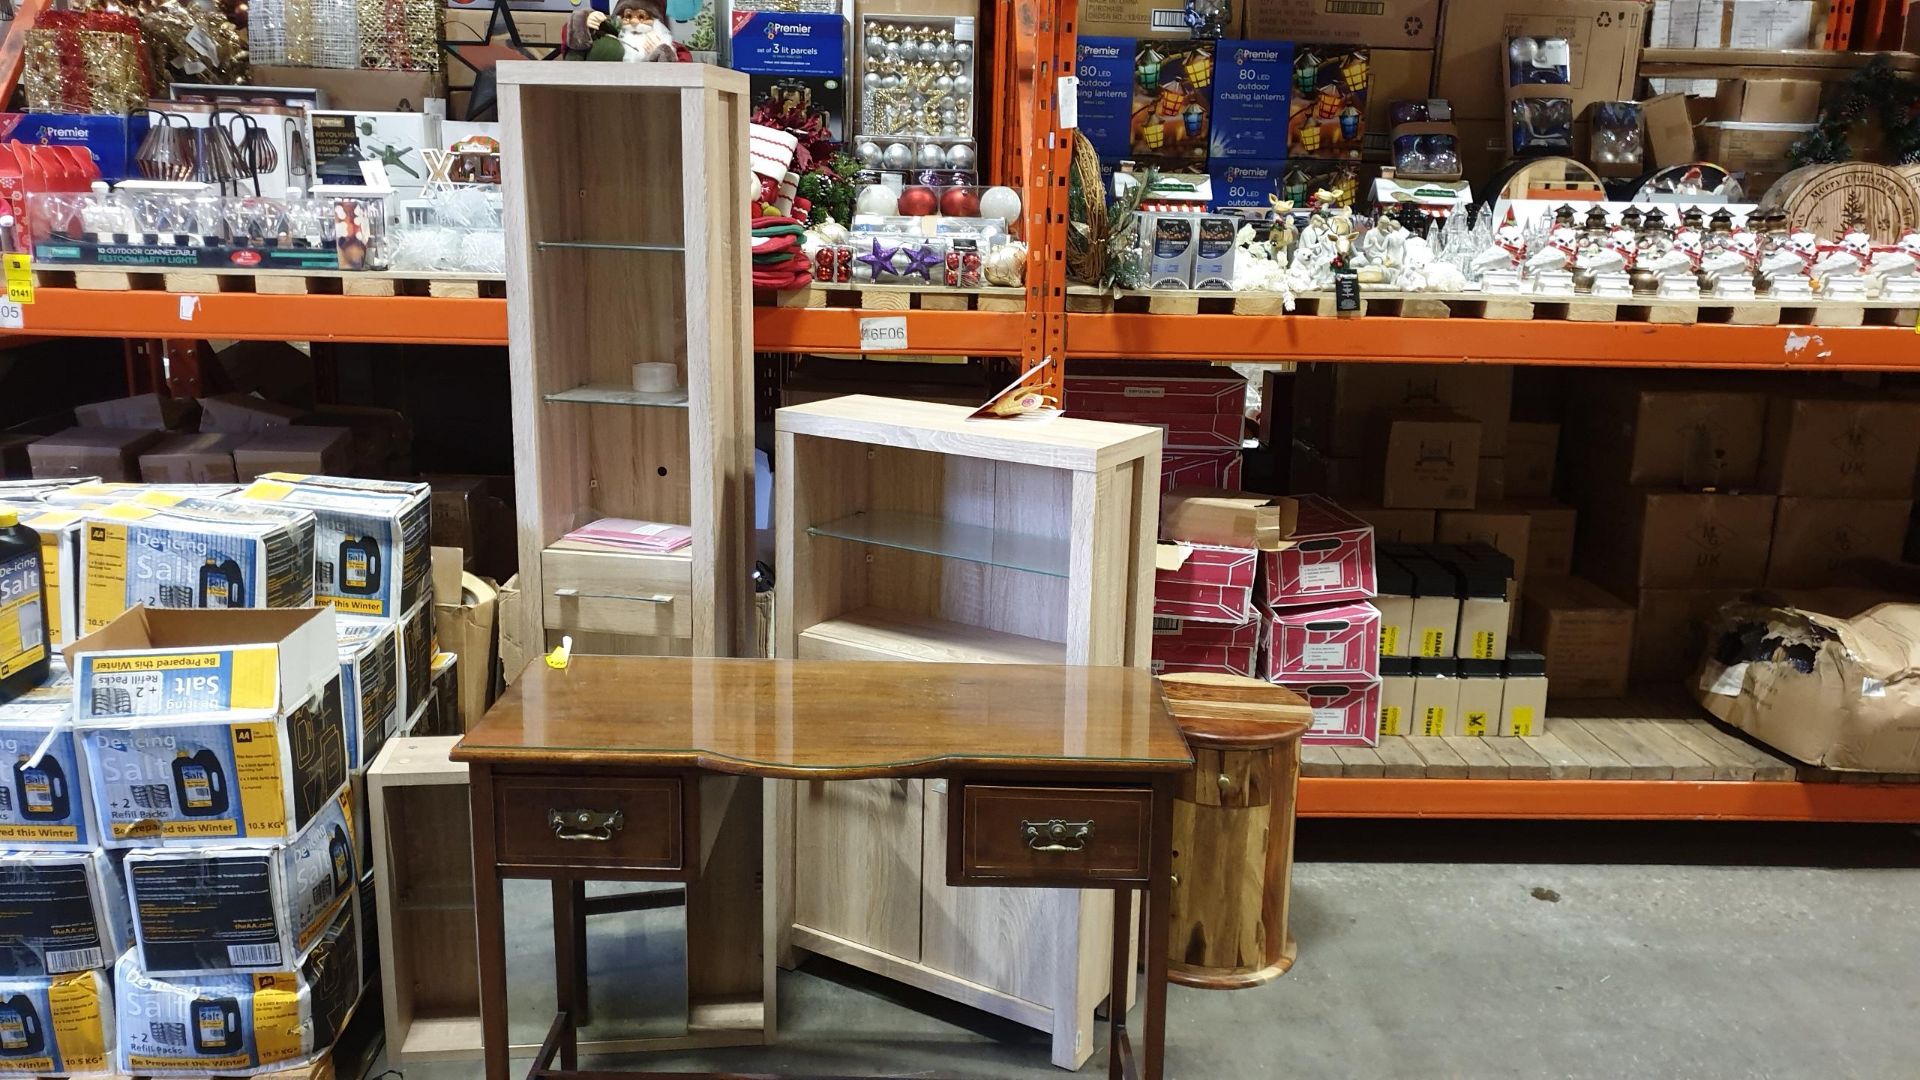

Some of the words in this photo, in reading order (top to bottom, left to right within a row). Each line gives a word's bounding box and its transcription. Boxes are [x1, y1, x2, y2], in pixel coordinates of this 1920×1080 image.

[774, 23, 811, 34] Premier
[773, 43, 780, 54] 3
[781, 46, 789, 54] lit
[790, 47, 818, 55] parcels
[1084, 46, 1120, 55] Premier
[1243, 49, 1278, 59] Premier
[1080, 65, 1097, 77] 80
[1239, 69, 1256, 80] 80
[1095, 90, 1127, 98] lanterns
[1220, 92, 1252, 101] chasing
[1253, 93, 1286, 101] lanterns
[47, 127, 89, 137] Premier
[1234, 167, 1269, 176] Premier
[1229, 187, 1245, 197] 80
[1811, 180, 1841, 199] Merry
[106, 247, 142, 255] OUTDOOR
[144, 248, 197, 256] CONNECTABLE
[98, 255, 137, 263] FESTOON
[168, 256, 198, 264] LIGHTS
[10, 289, 29, 297] 0141
[92, 529, 104, 538] AA
[136, 532, 207, 555] De-icing
[348, 552, 364, 562] Salt
[1697, 553, 1720, 566] UK
[0, 557, 36, 578] De-icing
[137, 554, 197, 583] Salt
[1, 570, 38, 600] Salt
[148, 597, 155, 607] 2
[335, 600, 349, 608] this
[351, 601, 380, 610] Winter
[88, 618, 104, 627] 10.5
[96, 662, 132, 670] Winter
[135, 660, 154, 668] this
[157, 658, 200, 668] Prepared
[204, 657, 216, 665] Be
[99, 675, 128, 684] Packs
[131, 675, 158, 683] Refill
[175, 675, 219, 696] Salt
[136, 686, 144, 698] 2
[238, 731, 250, 740] AA
[96, 735, 177, 750] De-icing
[103, 757, 170, 782] Salt
[25, 775, 45, 784] Salt
[184, 771, 204, 780] Salt
[123, 798, 130, 808] 2
[111, 810, 137, 819] Refill
[139, 810, 169, 819] Packs
[177, 823, 196, 833] this
[199, 823, 233, 833] Winter
[248, 822, 266, 831] 10.5
[17, 829, 36, 837] this
[38, 829, 74, 838] Winter
[294, 824, 327, 864] De-icing
[298, 852, 331, 894] Salt
[52, 926, 94, 935] theAA.com
[235, 922, 274, 930] theAA.com
[127, 992, 186, 1018] Salt
[200, 1011, 220, 1020] Salt
[141, 1033, 148, 1042] 2
[131, 1043, 155, 1051] Refill
[157, 1046, 183, 1055] Packs
[17, 1060, 50, 1069] Winter
[131, 1057, 143, 1065] Be
[145, 1059, 189, 1067] Prepared
[212, 1057, 247, 1067] Winter
